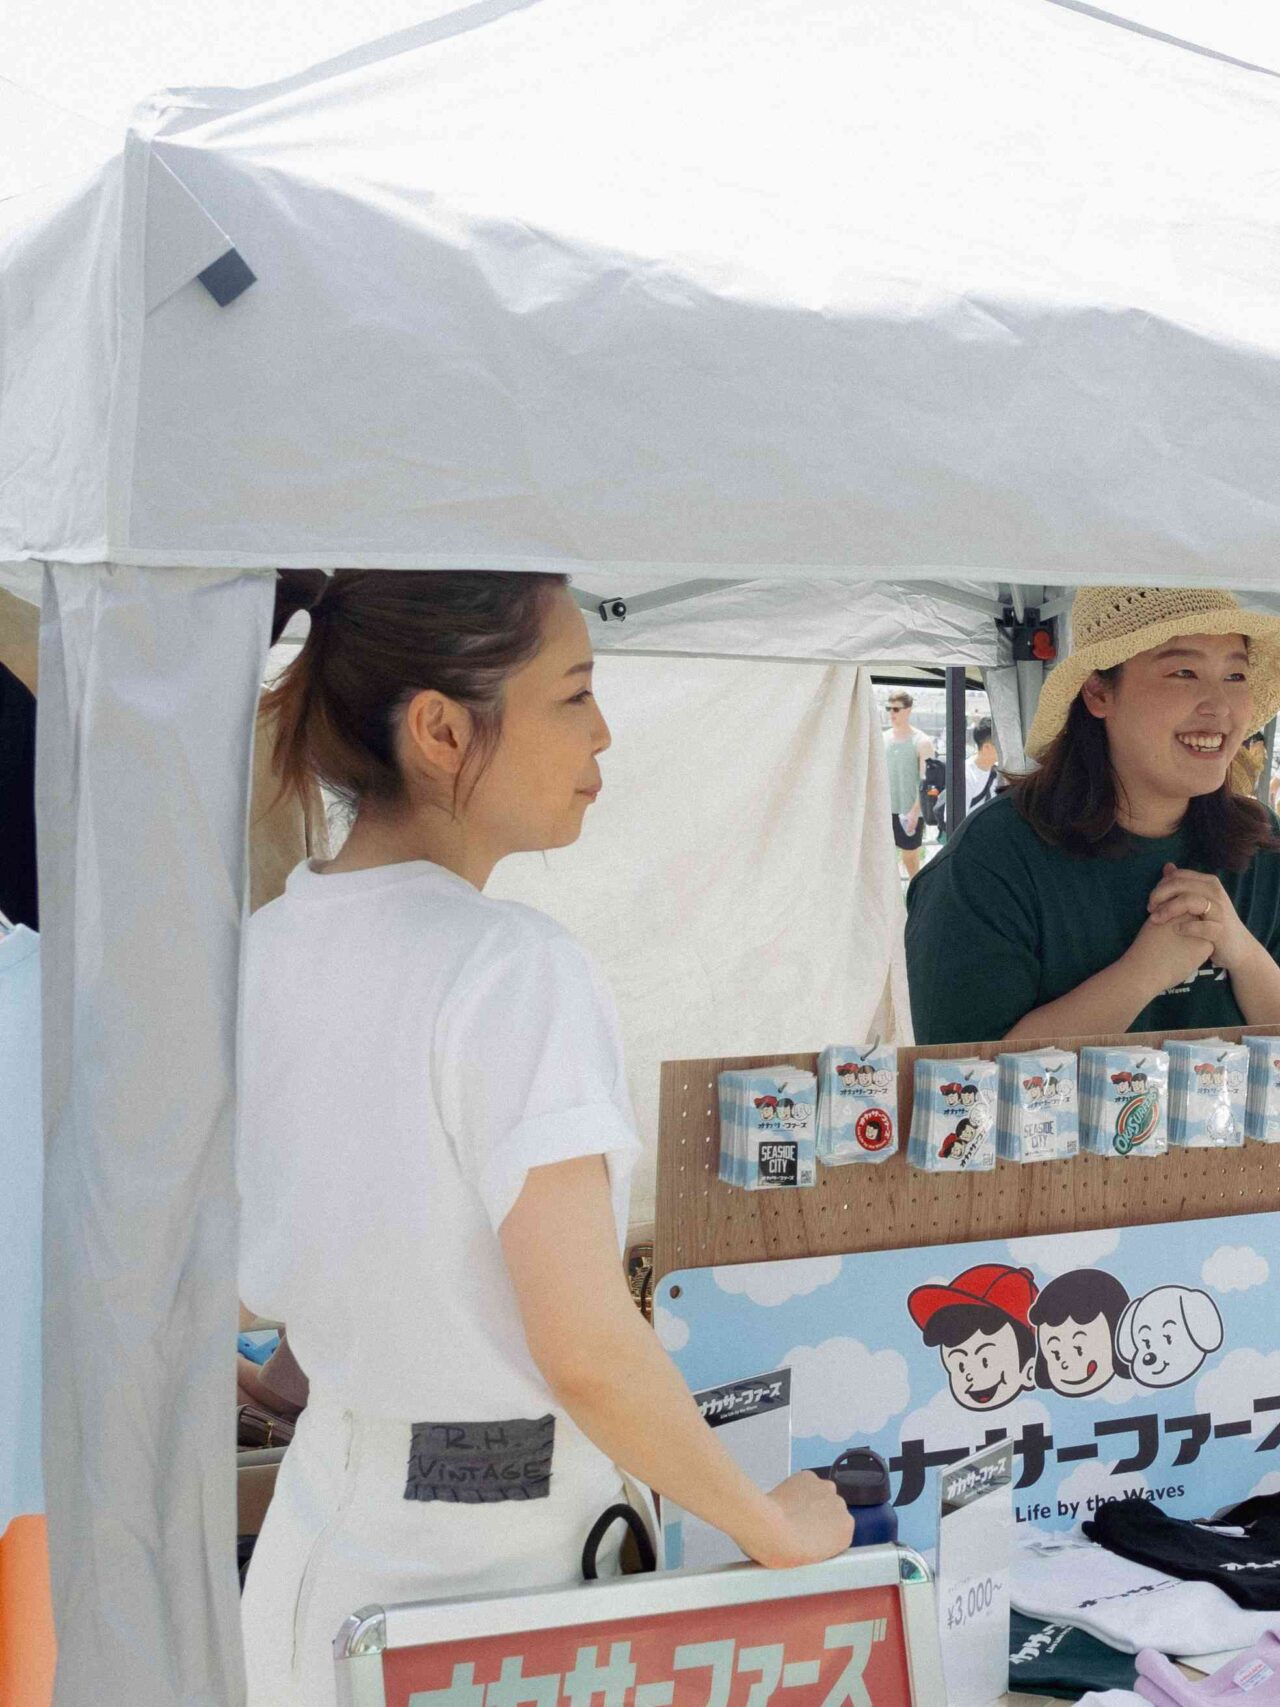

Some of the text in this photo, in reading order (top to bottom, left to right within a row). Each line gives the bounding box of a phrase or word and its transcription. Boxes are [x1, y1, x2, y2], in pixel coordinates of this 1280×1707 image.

[761, 1144, 796, 1162] SEASIDE
[768, 1159, 788, 1174] CITY
[1015, 1503, 1051, 1523] Life
[1057, 1500, 1080, 1519] by
[1123, 1484, 1185, 1502] Waves
